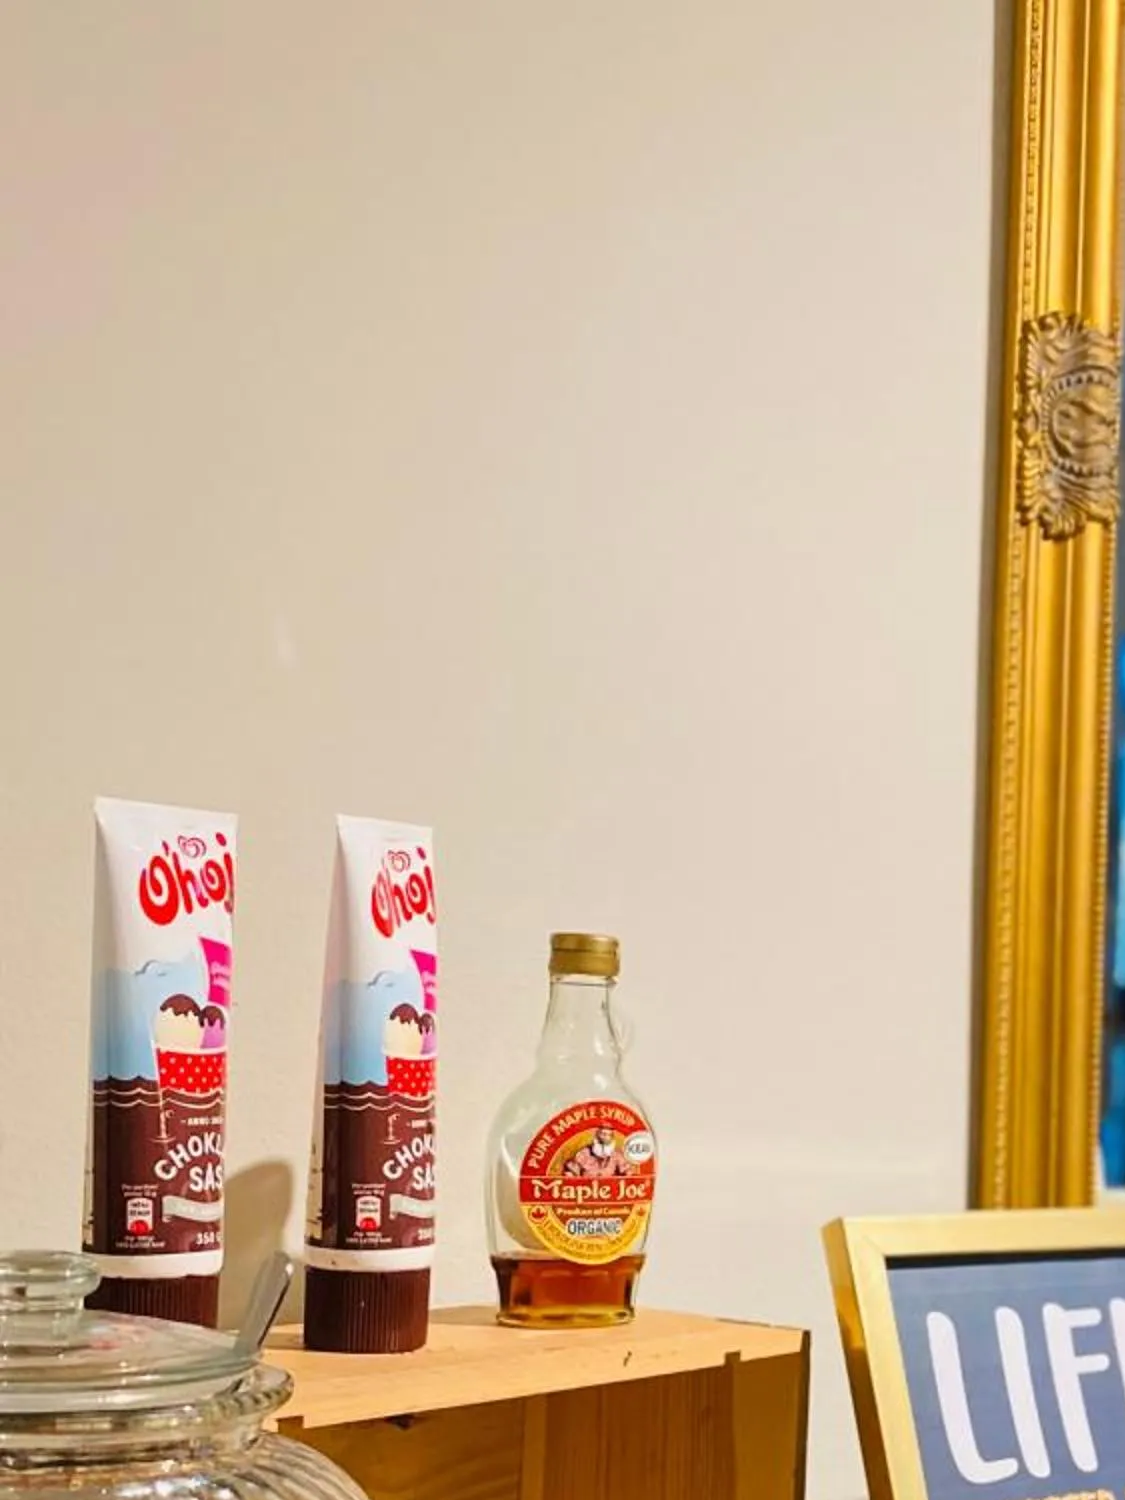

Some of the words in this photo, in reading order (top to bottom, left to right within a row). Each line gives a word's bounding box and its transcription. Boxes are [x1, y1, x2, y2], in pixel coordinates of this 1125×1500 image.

[527, 1132, 556, 1169] PURE
[551, 1105, 597, 1137] MAPLE
[599, 1105, 636, 1127] SYRUP
[531, 1179, 612, 1204] Maple
[566, 1219, 623, 1236] ORGANIC
